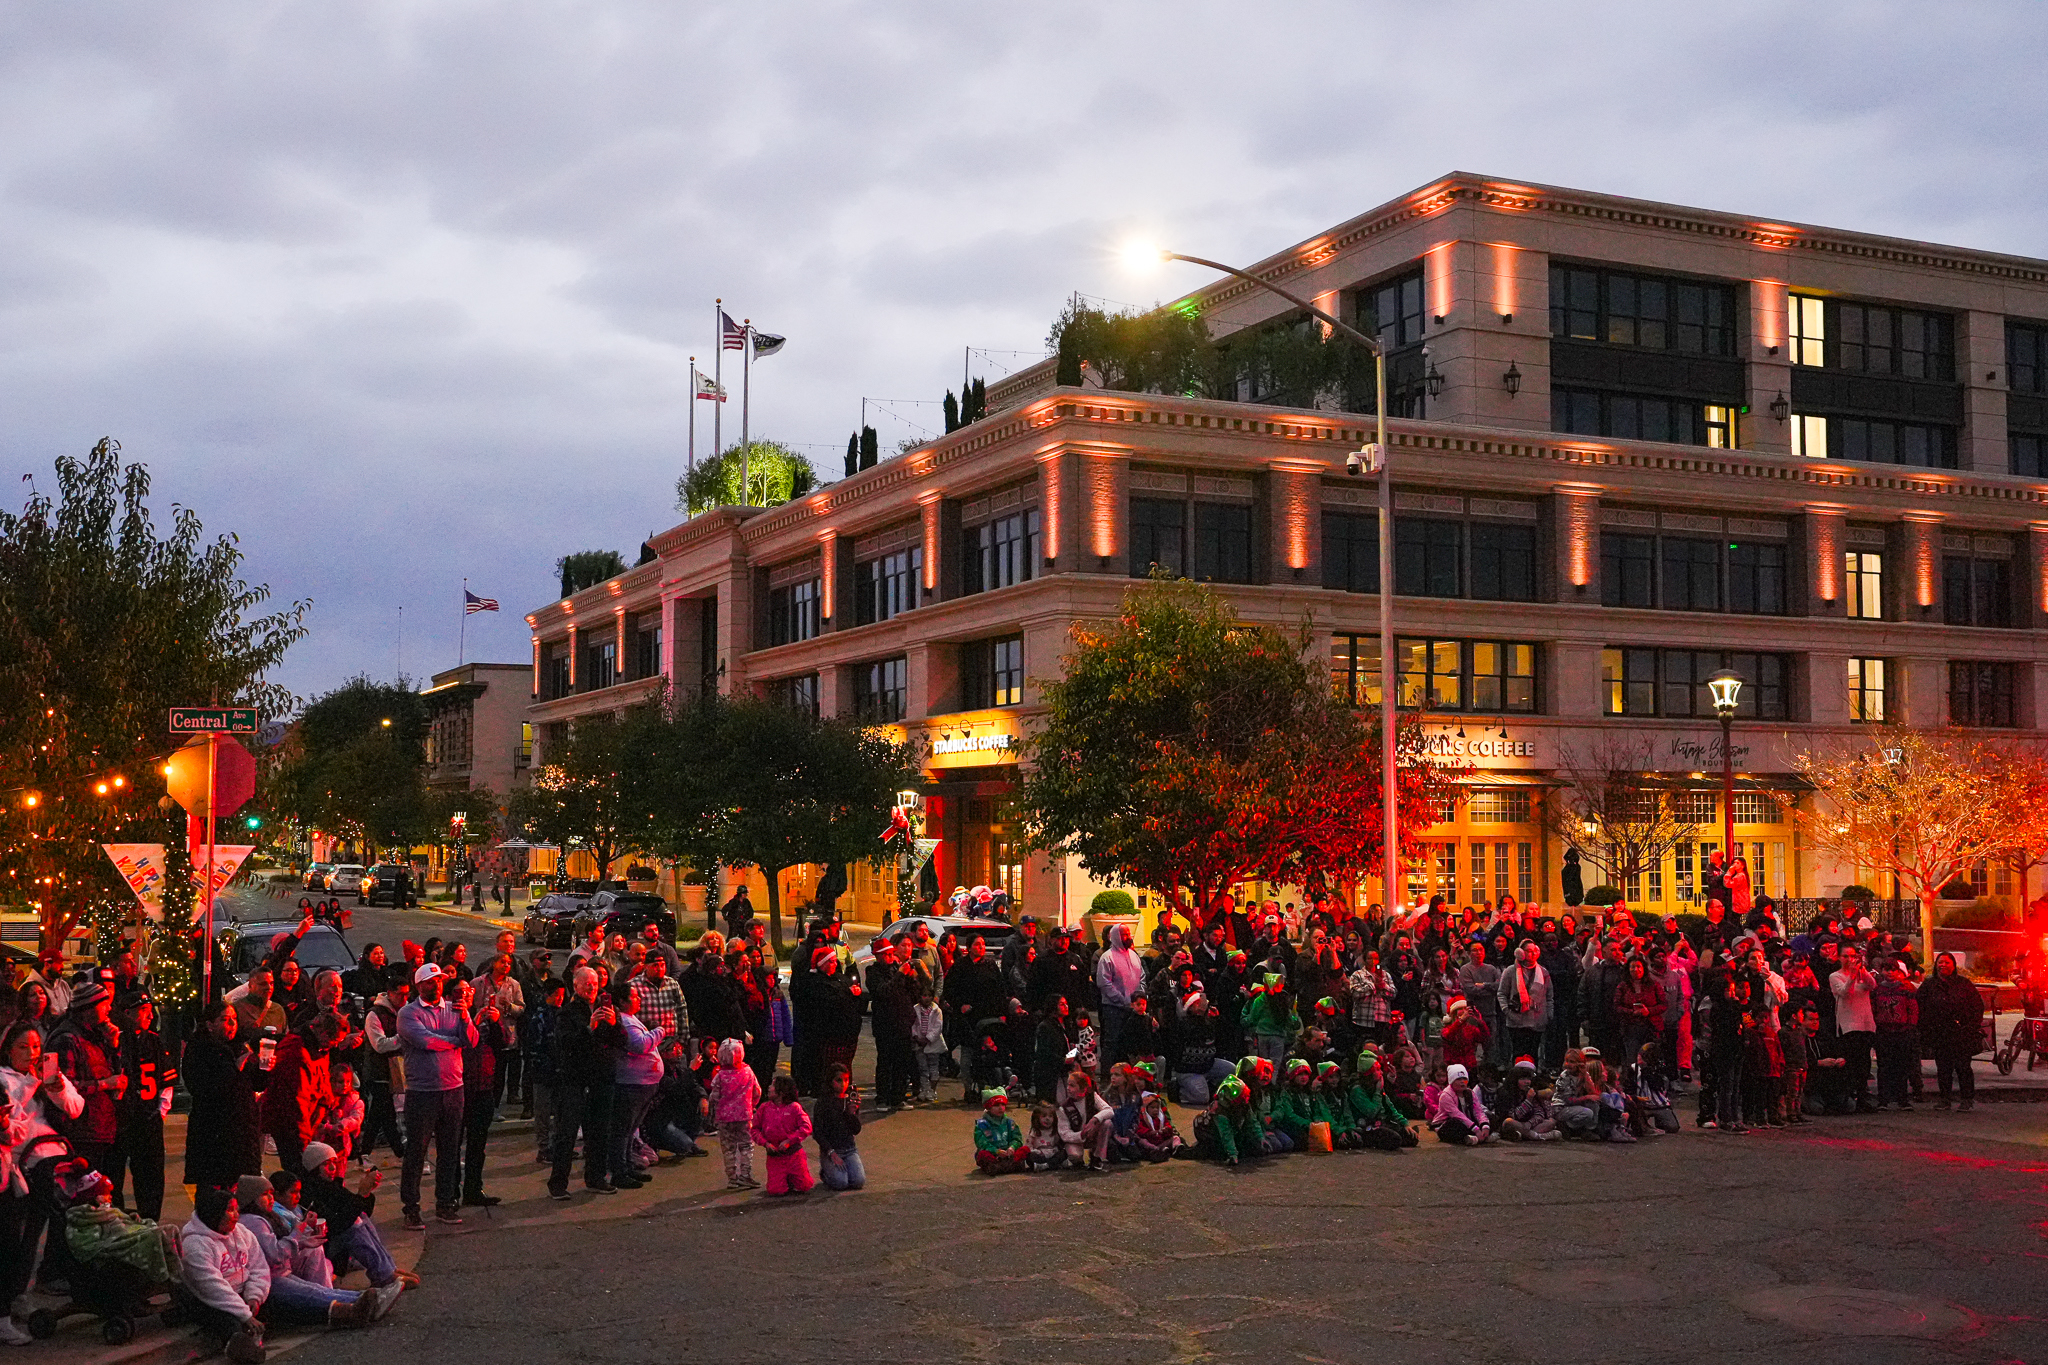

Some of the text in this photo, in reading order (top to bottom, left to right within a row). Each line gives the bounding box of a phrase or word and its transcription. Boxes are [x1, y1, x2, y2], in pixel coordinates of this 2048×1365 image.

[173, 711, 246, 728] Central Ave
[934, 734, 1009, 754] STARBUCKS COFFEE
[1468, 740, 1535, 756] COFFEE
[1671, 737, 1706, 766] Vintage
